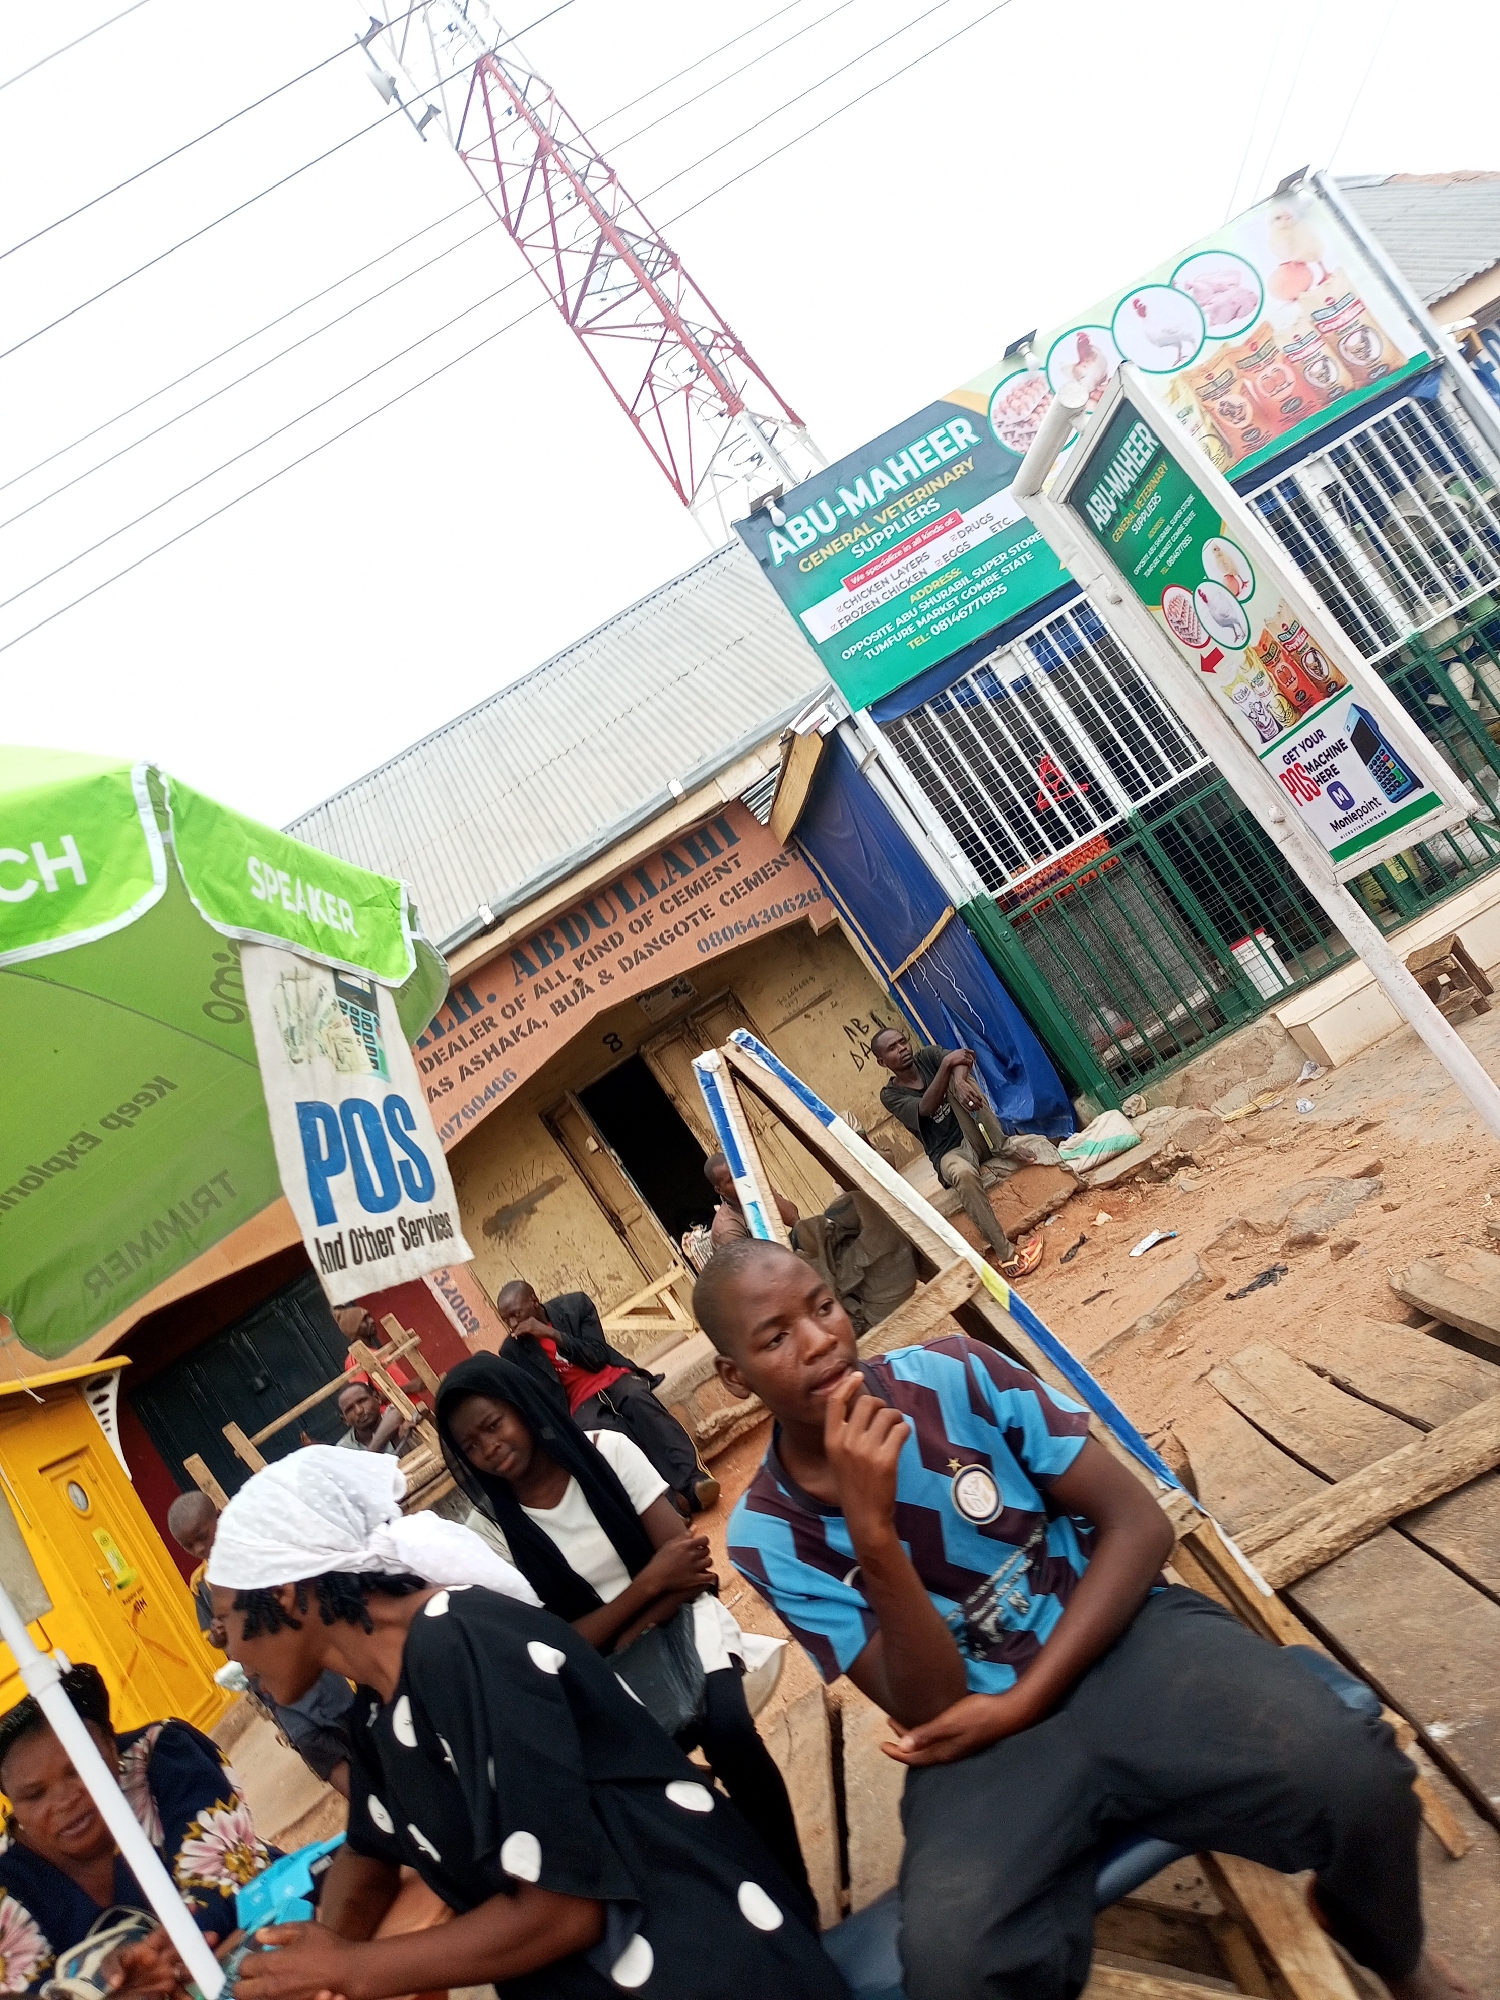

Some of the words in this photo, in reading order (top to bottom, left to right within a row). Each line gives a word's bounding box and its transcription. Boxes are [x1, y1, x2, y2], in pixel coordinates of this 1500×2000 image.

[767, 417, 982, 566] ABU-MAHEER
[1085, 421, 1159, 532] ABU-MAHEER
[1112, 509, 1138, 543] GENERAL
[1134, 460, 1169, 511] VETERINARY
[799, 521, 876, 572] GENERAL
[873, 456, 975, 525] VETERINARY
[851, 497, 941, 558] SUPPLIERS
[957, 513, 995, 541] DRUGS
[1131, 492, 1162, 535] SUPPLIERS
[842, 579, 890, 611] CHICKEN
[890, 551, 931, 584] LAYERS
[849, 572, 864, 585] We
[864, 548, 902, 576] specialize
[901, 543, 913, 554] in
[911, 535, 924, 549] all
[922, 523, 945, 542] kinds
[909, 567, 962, 604] ADDRESS:
[942, 541, 972, 565] EGGS
[838, 598, 880, 629] FROZEN
[881, 567, 929, 601] CHICKEN
[841, 621, 895, 660] OPPOSITE
[895, 607, 919, 627] ABU
[920, 577, 973, 611] SHURABIL
[972, 553, 1008, 580] SUPER
[1007, 531, 1044, 559] STORE
[863, 622, 917, 660] TUMFURE
[915, 597, 961, 627] MARKET
[960, 571, 1001, 600] GOMBE
[1000, 551, 1035, 577] STATE
[929, 583, 1009, 636] 08146771955
[1279, 762, 1321, 806] POS
[1305, 738, 1348, 775] MACHINE
[1282, 746, 1302, 765] GET
[1300, 728, 1327, 752] YOUR
[1313, 764, 1340, 787] HERE
[1330, 796, 1382, 833] Moniepoint
[0, 835, 87, 902] CH
[247, 855, 359, 938] SPEAKER
[509, 816, 741, 986] ABDULLAHI
[418, 1016, 499, 1075] DEALER
[500, 993, 526, 1020] OF
[533, 968, 572, 1000] ALL
[572, 931, 625, 972] KIND
[628, 909, 655, 935] OF
[659, 852, 742, 914] CEMENT
[426, 1076, 454, 1104] AS
[458, 1017, 549, 1082] ASHAKA,
[549, 978, 595, 1017] BUA
[597, 968, 614, 986] &
[617, 903, 716, 974] DANGOTE
[719, 844, 800, 907] CEMENT
[602, 1031, 624, 1054] 8
[295, 1094, 435, 1227] POS
[313, 1232, 345, 1275] And
[349, 1225, 396, 1265] Other
[399, 1210, 454, 1252] Services
